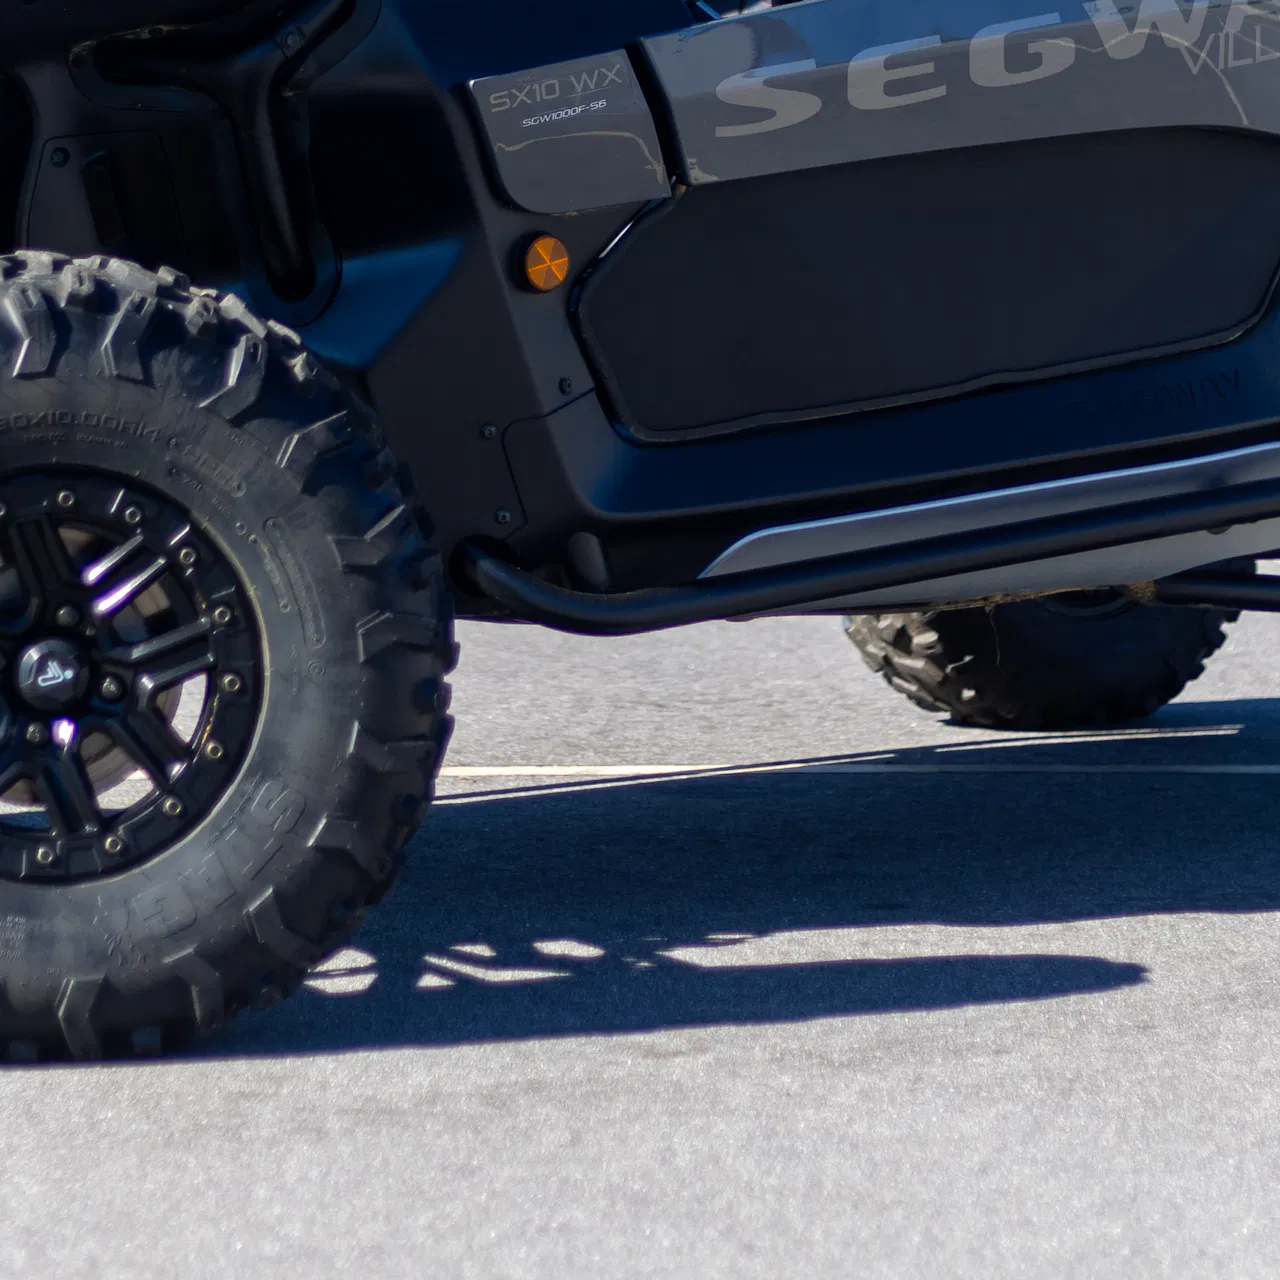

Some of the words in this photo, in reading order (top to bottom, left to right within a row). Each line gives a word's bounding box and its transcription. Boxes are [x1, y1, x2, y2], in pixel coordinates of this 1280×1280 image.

[489, 79, 560, 113] SX10
[570, 64, 622, 93] WX
[522, 99, 607, 127] SGW1000F-S6
